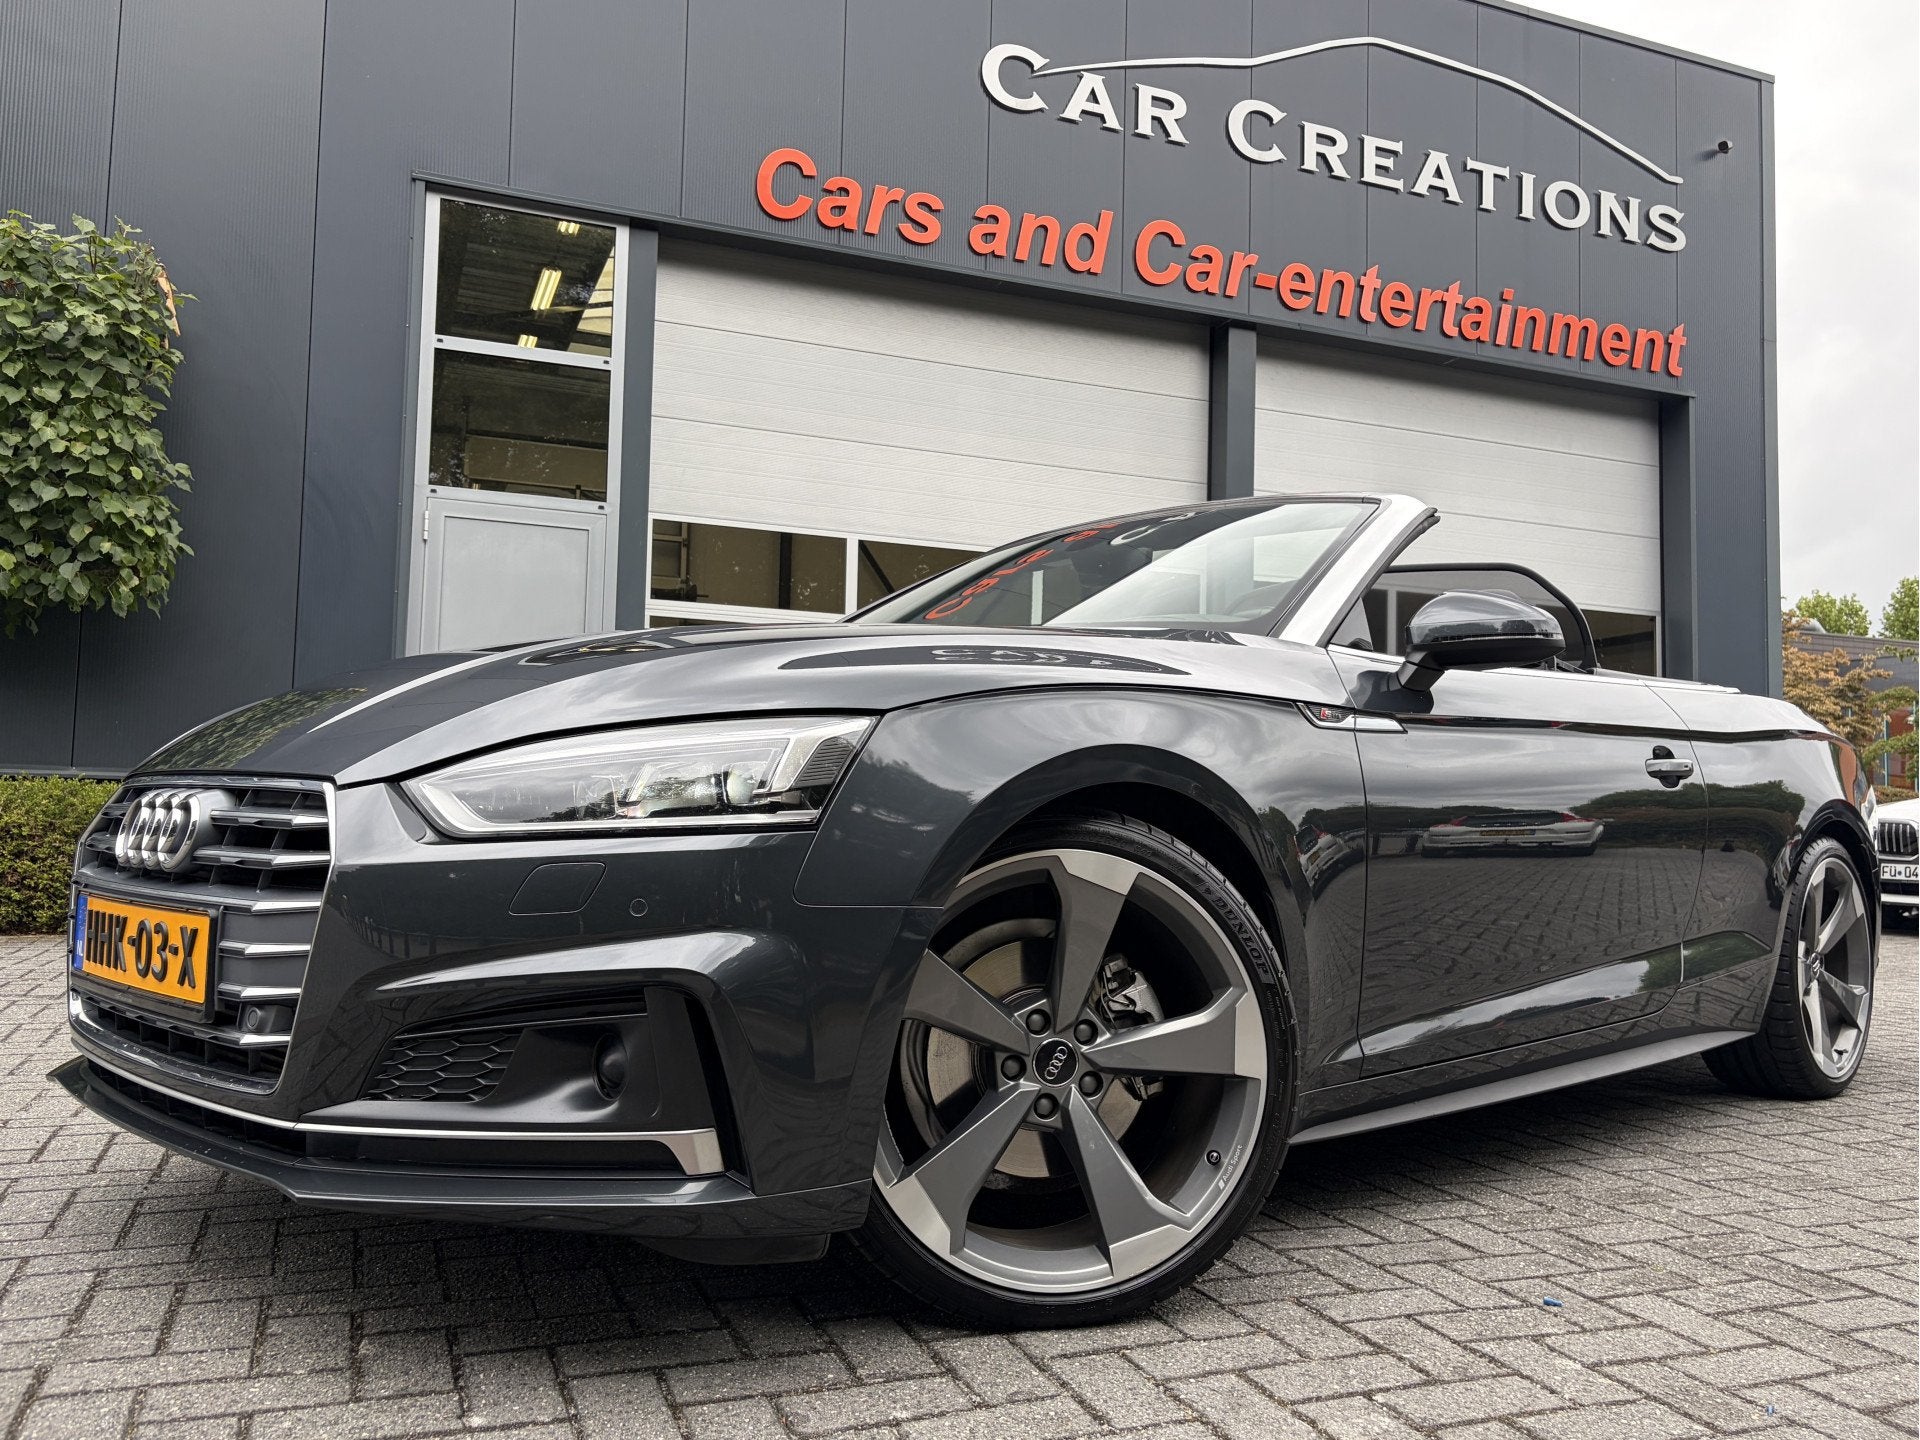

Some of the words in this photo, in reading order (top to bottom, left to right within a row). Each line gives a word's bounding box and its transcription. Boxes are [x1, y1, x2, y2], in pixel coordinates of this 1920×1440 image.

[981, 43, 1190, 145] CAR
[1228, 99, 1688, 252] CREATIONS
[756, 148, 944, 244] Cars
[969, 199, 1114, 274] and
[1135, 220, 1687, 377] Car-entertainment
[85, 909, 199, 989] HHK-03-X
[1212, 896, 1269, 976] DUNLOP
